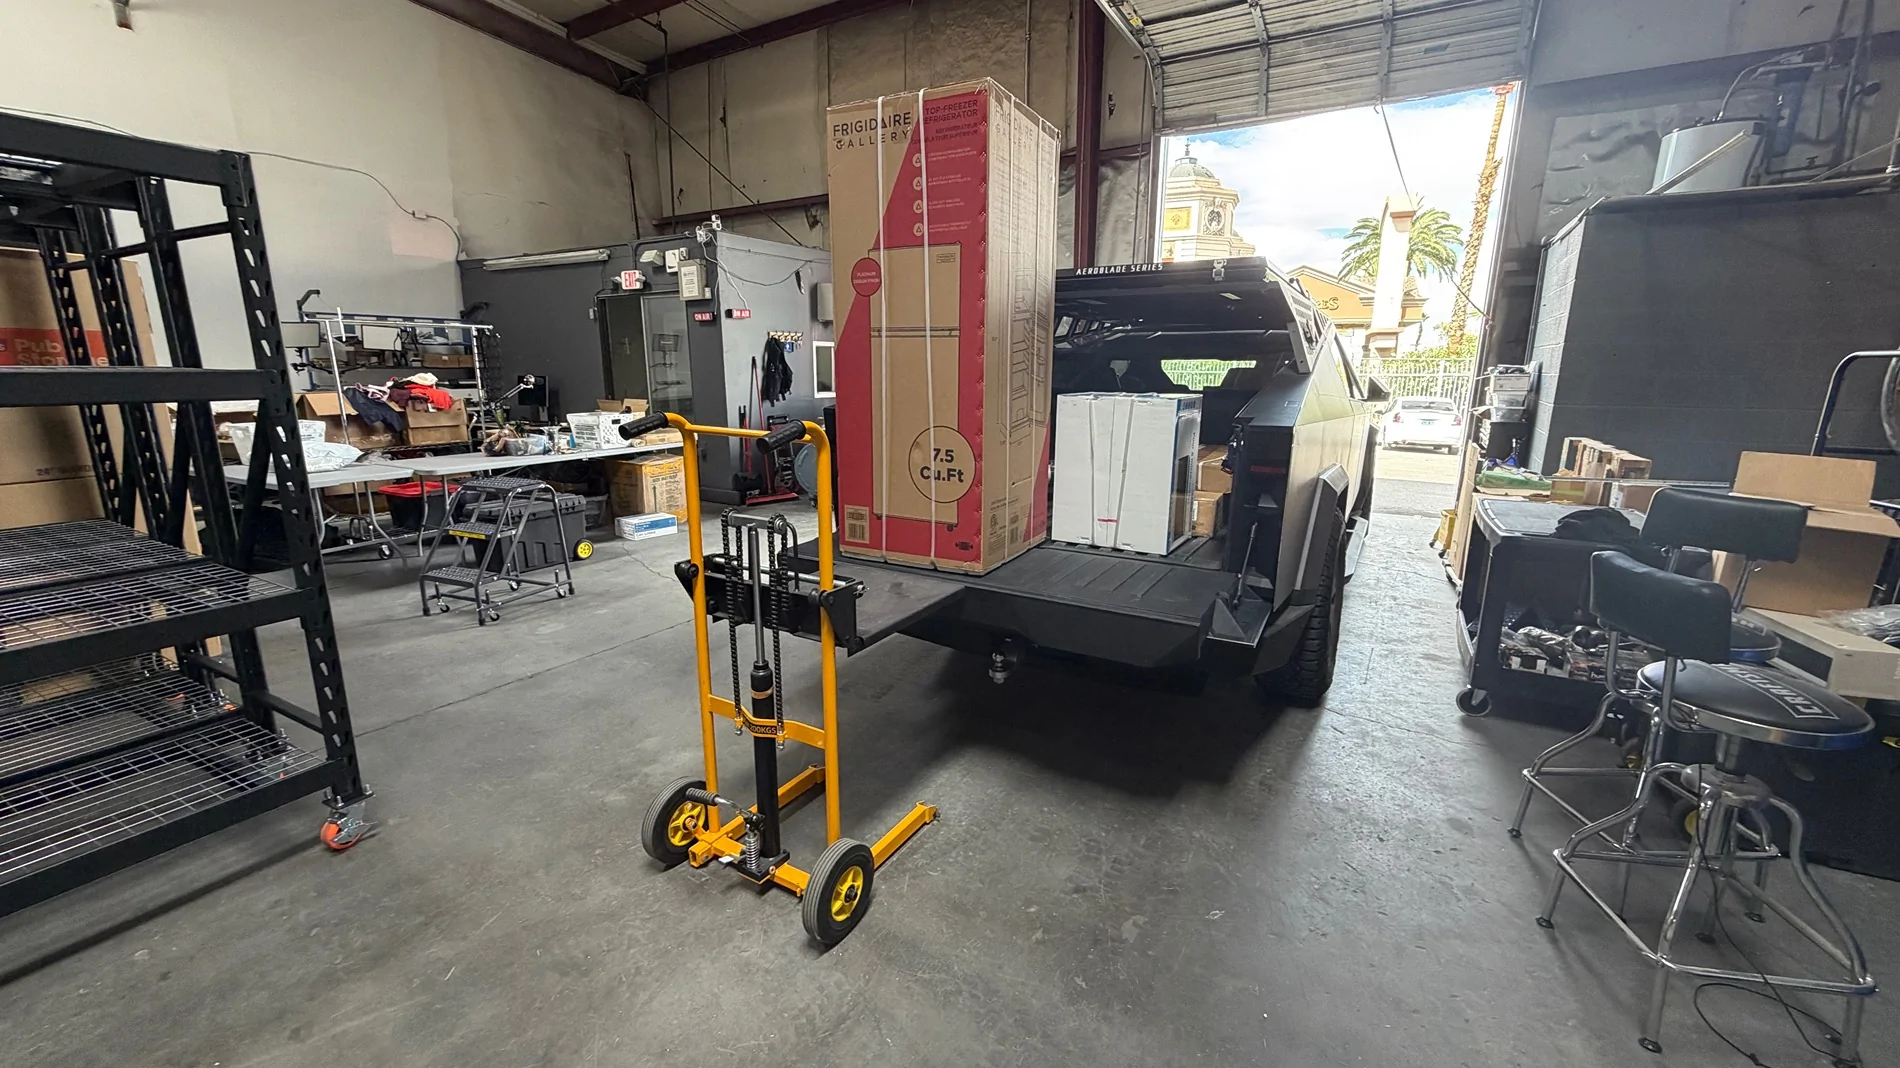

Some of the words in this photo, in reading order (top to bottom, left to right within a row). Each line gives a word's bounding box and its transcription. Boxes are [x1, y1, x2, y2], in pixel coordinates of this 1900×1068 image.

[925, 100, 978, 115] TOP-FREEZER
[922, 109, 978, 124] EFRIGERATOR
[833, 112, 911, 137] FRIGIDAIRE
[1076, 265, 1127, 276] AEROBLADE
[1130, 263, 1164, 272] SERIES
[624, 271, 638, 288] EXIT
[932, 448, 955, 463] 7.5
